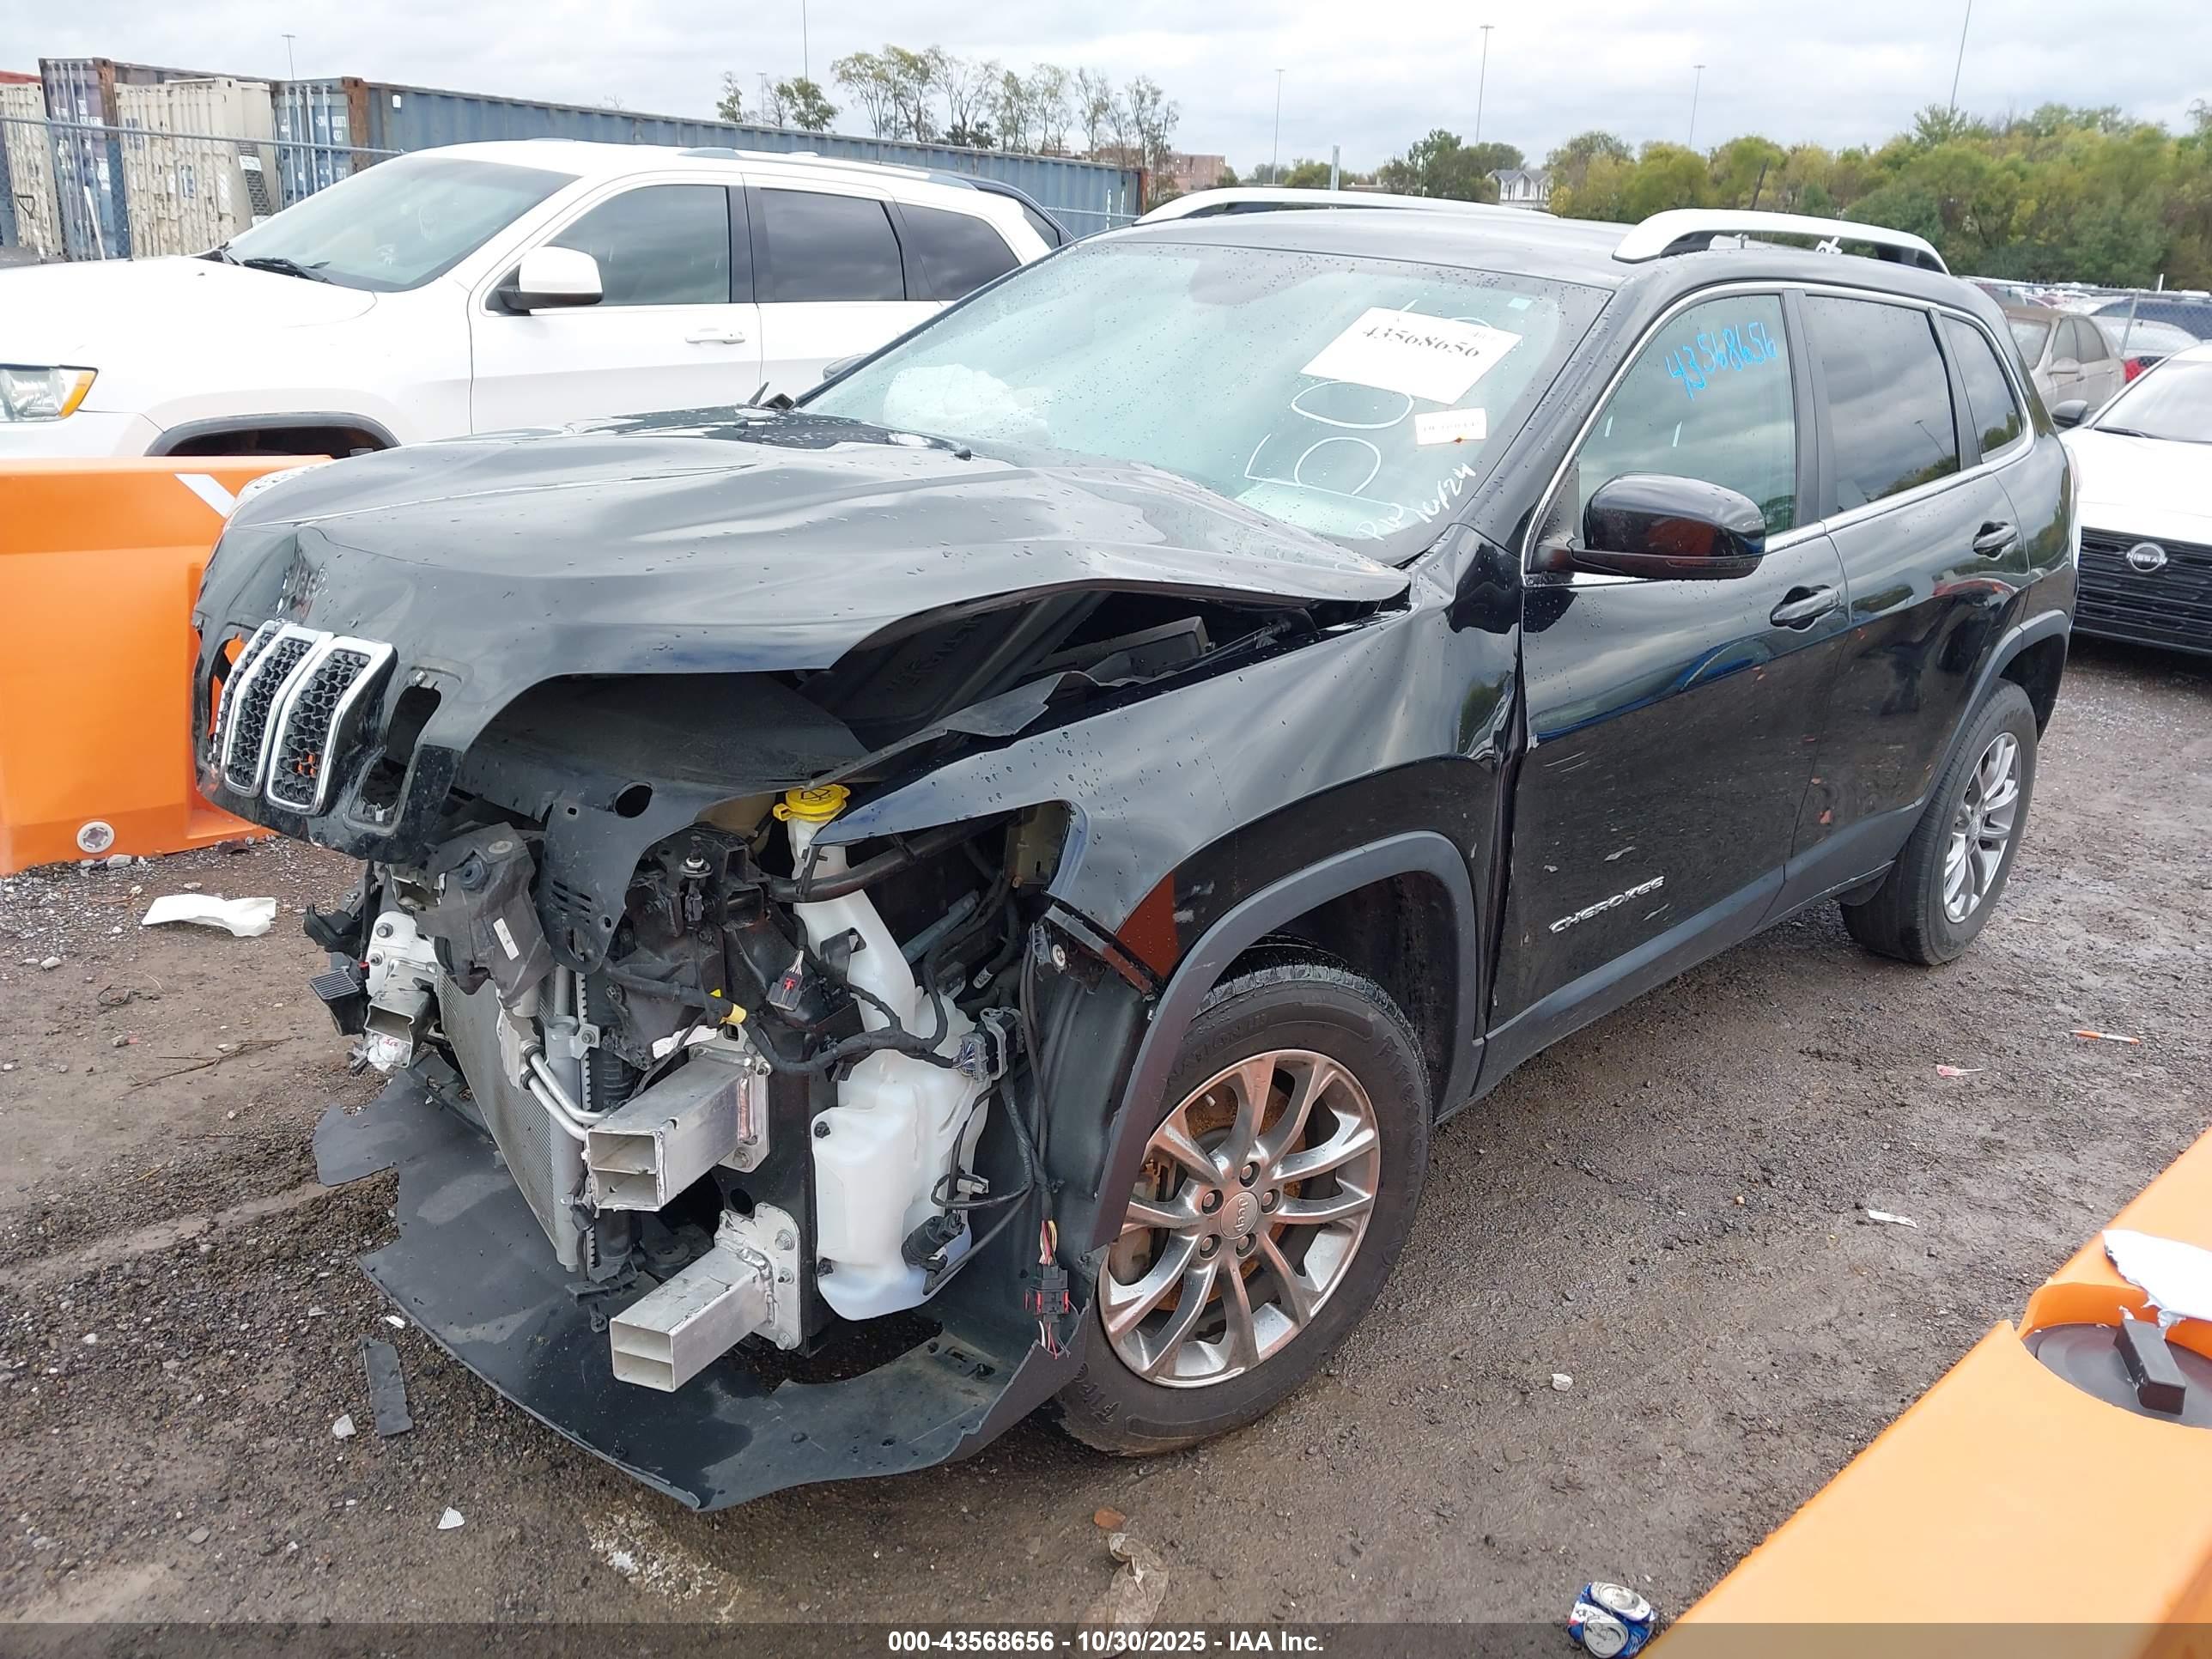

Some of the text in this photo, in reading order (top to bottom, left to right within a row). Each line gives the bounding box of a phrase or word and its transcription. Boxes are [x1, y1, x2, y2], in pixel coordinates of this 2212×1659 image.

[1362, 325, 1481, 358] 43568656
[1665, 321, 1778, 402] 43568656
[1547, 875, 1666, 934] CHEROKEE
[1233, 1194, 1249, 1232] Jeep
